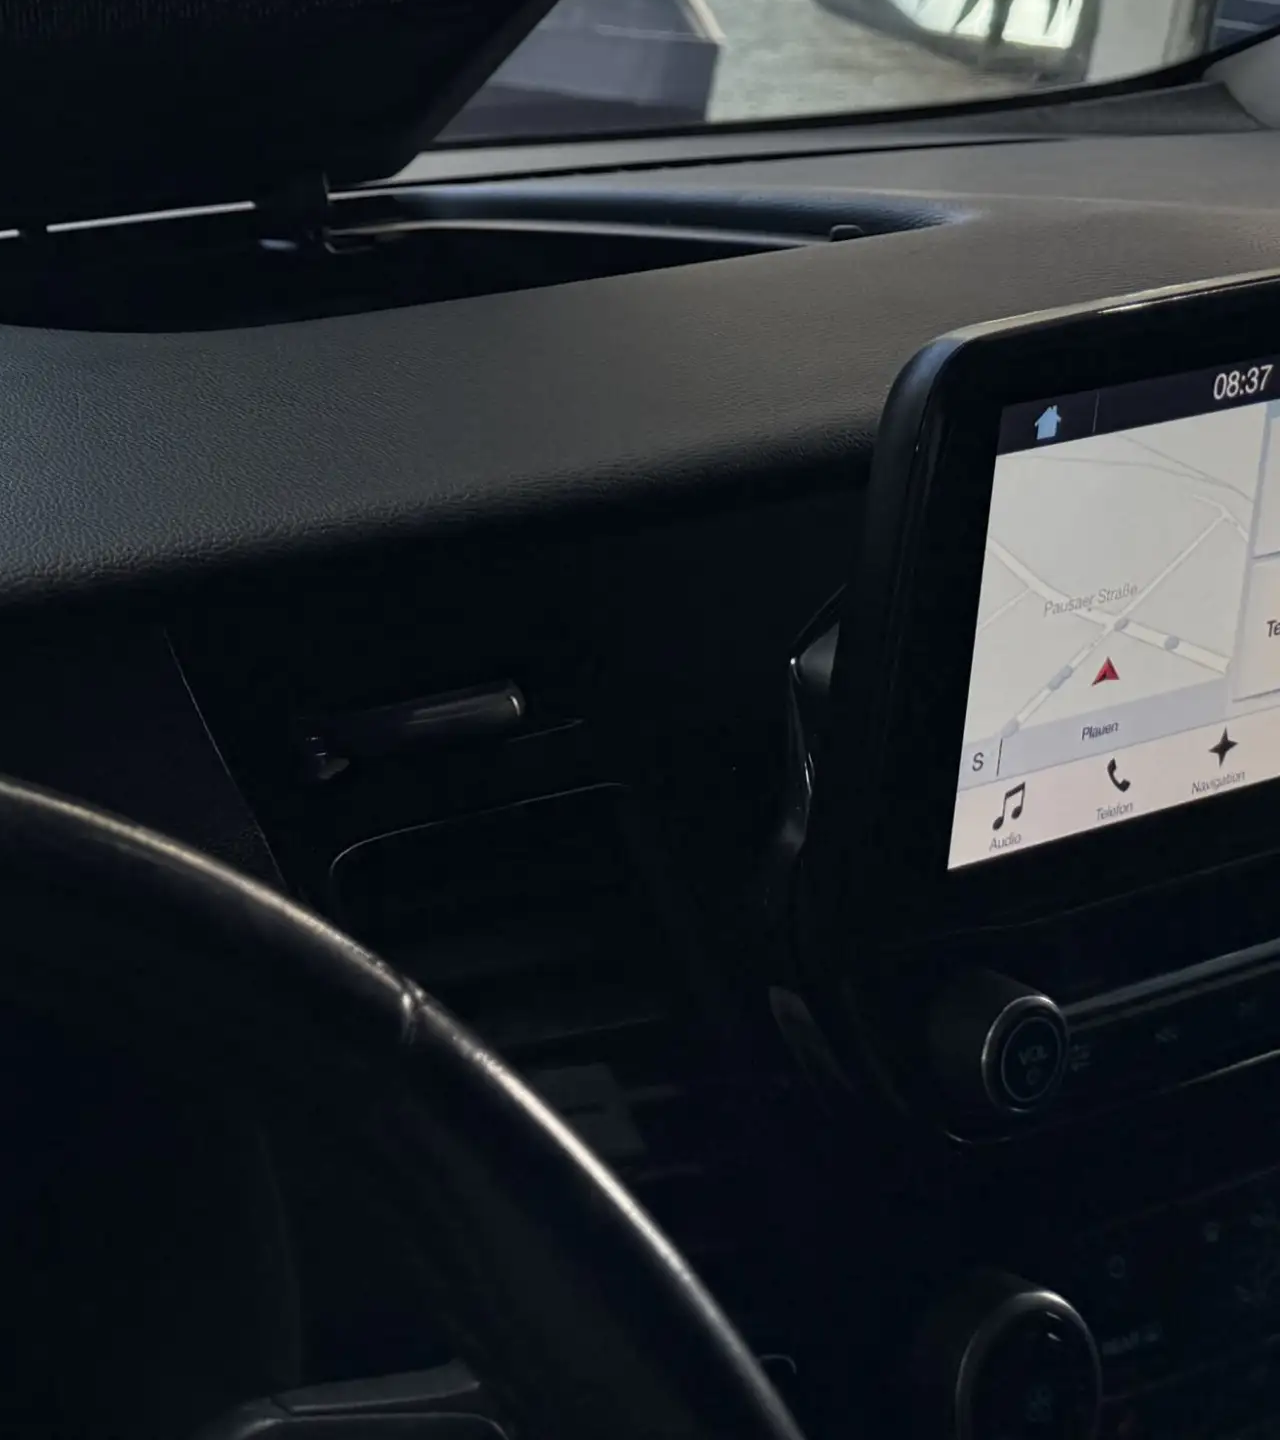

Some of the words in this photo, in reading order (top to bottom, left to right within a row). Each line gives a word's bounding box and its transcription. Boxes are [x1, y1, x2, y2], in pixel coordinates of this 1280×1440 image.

[1213, 364, 1274, 400] 08:37
[1043, 596, 1095, 618] Pausaer
[1097, 582, 1139, 604] Straße
[1081, 721, 1119, 741] Plauen
[972, 751, 984, 772] S
[1190, 770, 1246, 795] Navigation
[1096, 801, 1134, 821] Telefon
[989, 831, 1022, 852] Audio
